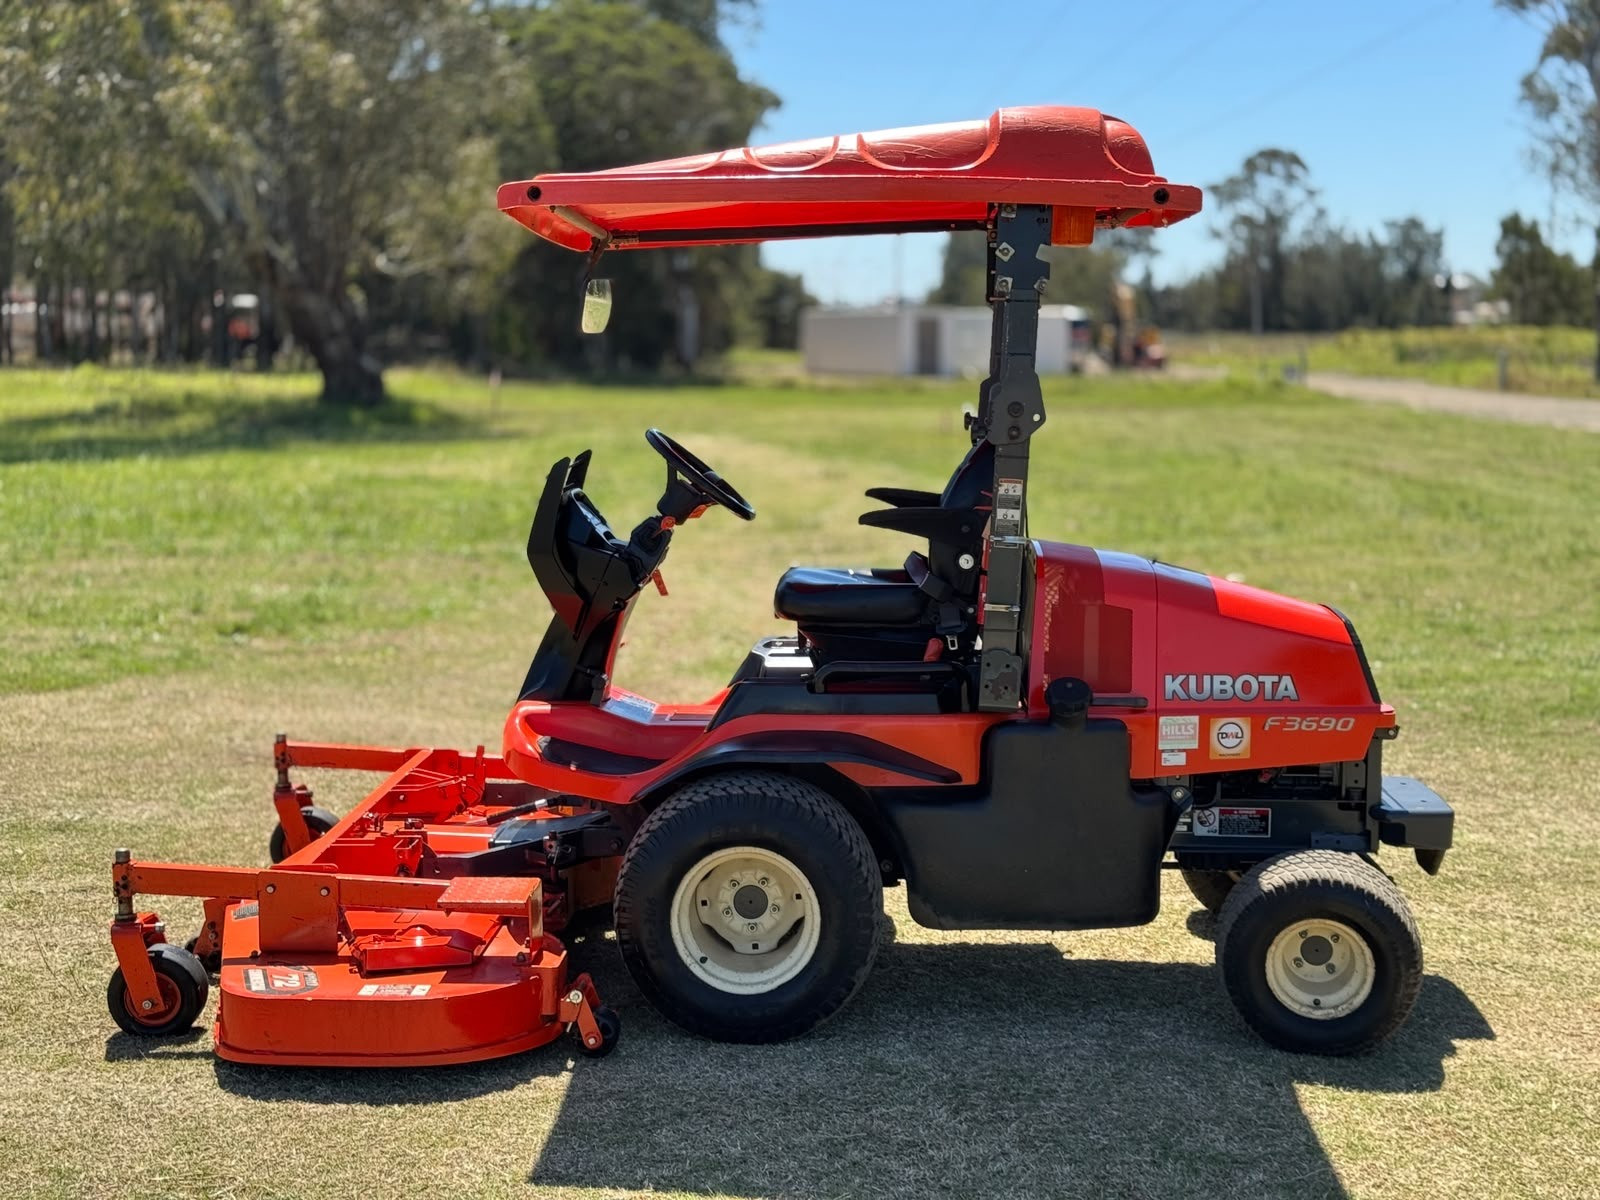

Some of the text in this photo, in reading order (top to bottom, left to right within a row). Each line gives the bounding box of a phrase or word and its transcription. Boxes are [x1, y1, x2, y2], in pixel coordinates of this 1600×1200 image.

[1163, 674, 1299, 701] KUBOTA
[1162, 724, 1194, 736] HILLS
[1264, 716, 1355, 731] F3690
[271, 973, 301, 988] 72
